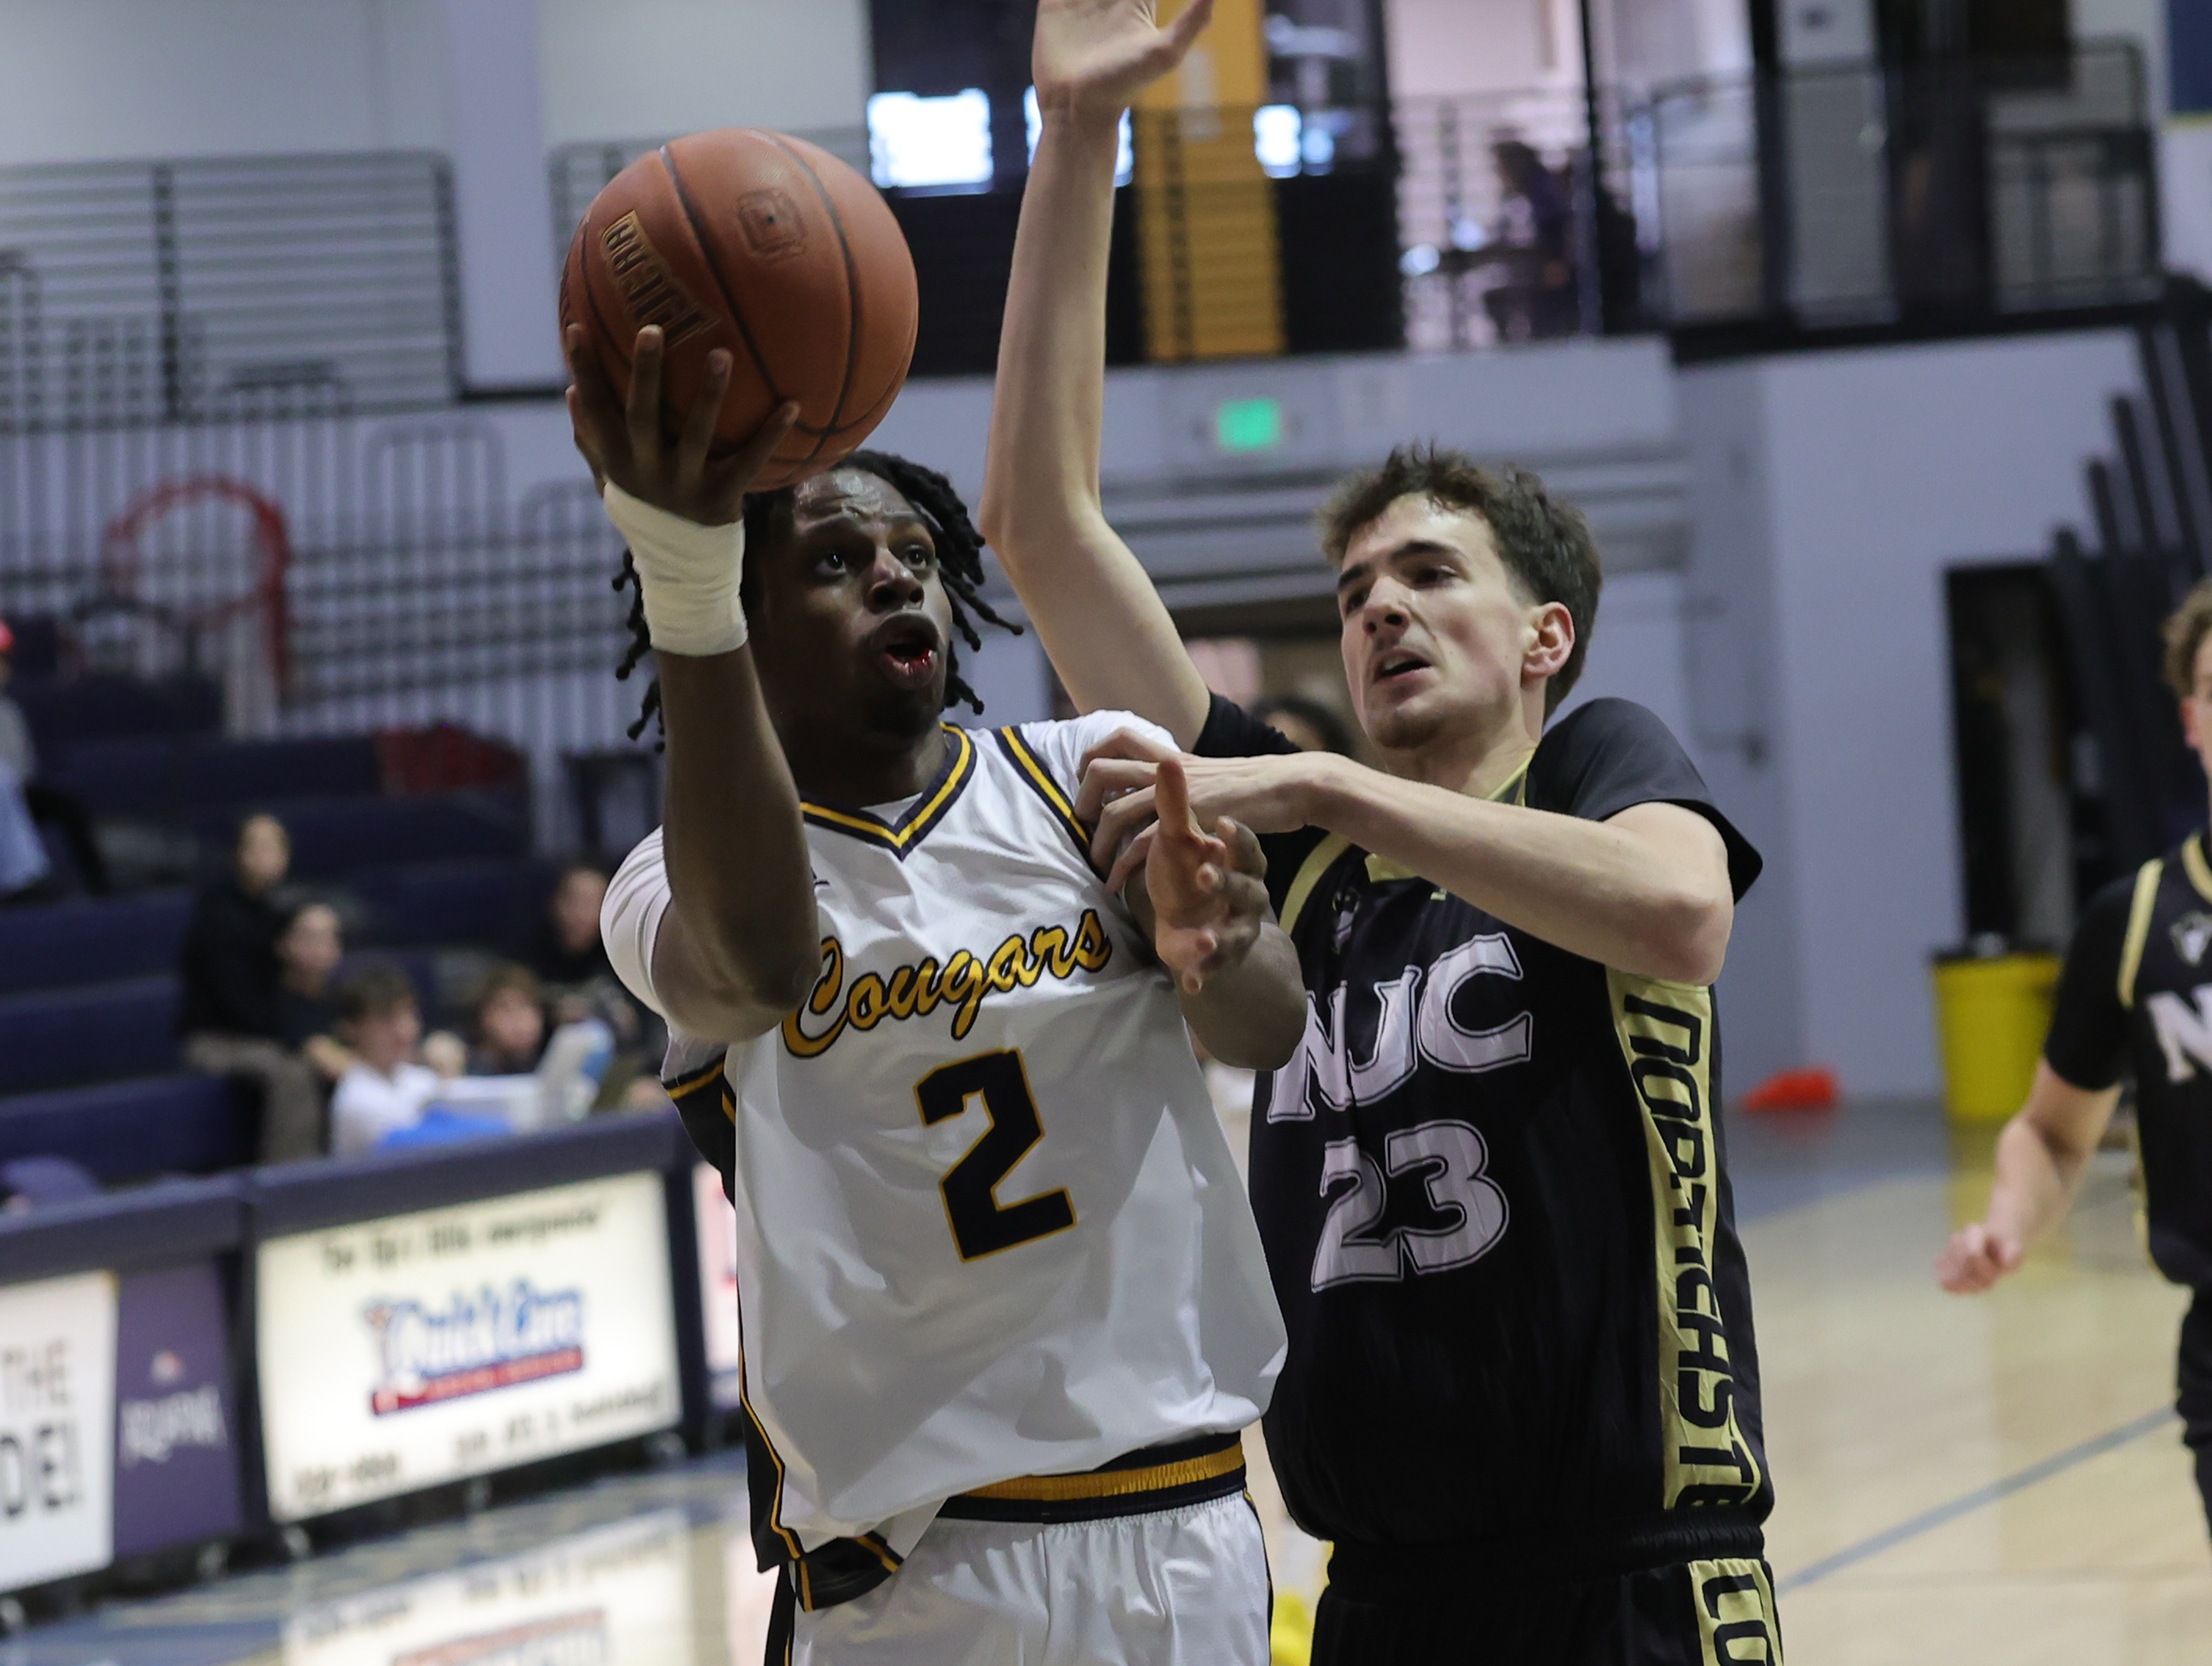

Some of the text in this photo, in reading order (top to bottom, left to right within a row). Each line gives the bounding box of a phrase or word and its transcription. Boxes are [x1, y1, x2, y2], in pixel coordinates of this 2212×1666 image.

[781, 908, 1113, 1057] Cougars
[1267, 932, 1533, 1124] NJC
[913, 1047, 1078, 1263] 2
[1311, 1119, 1510, 1293] 23
